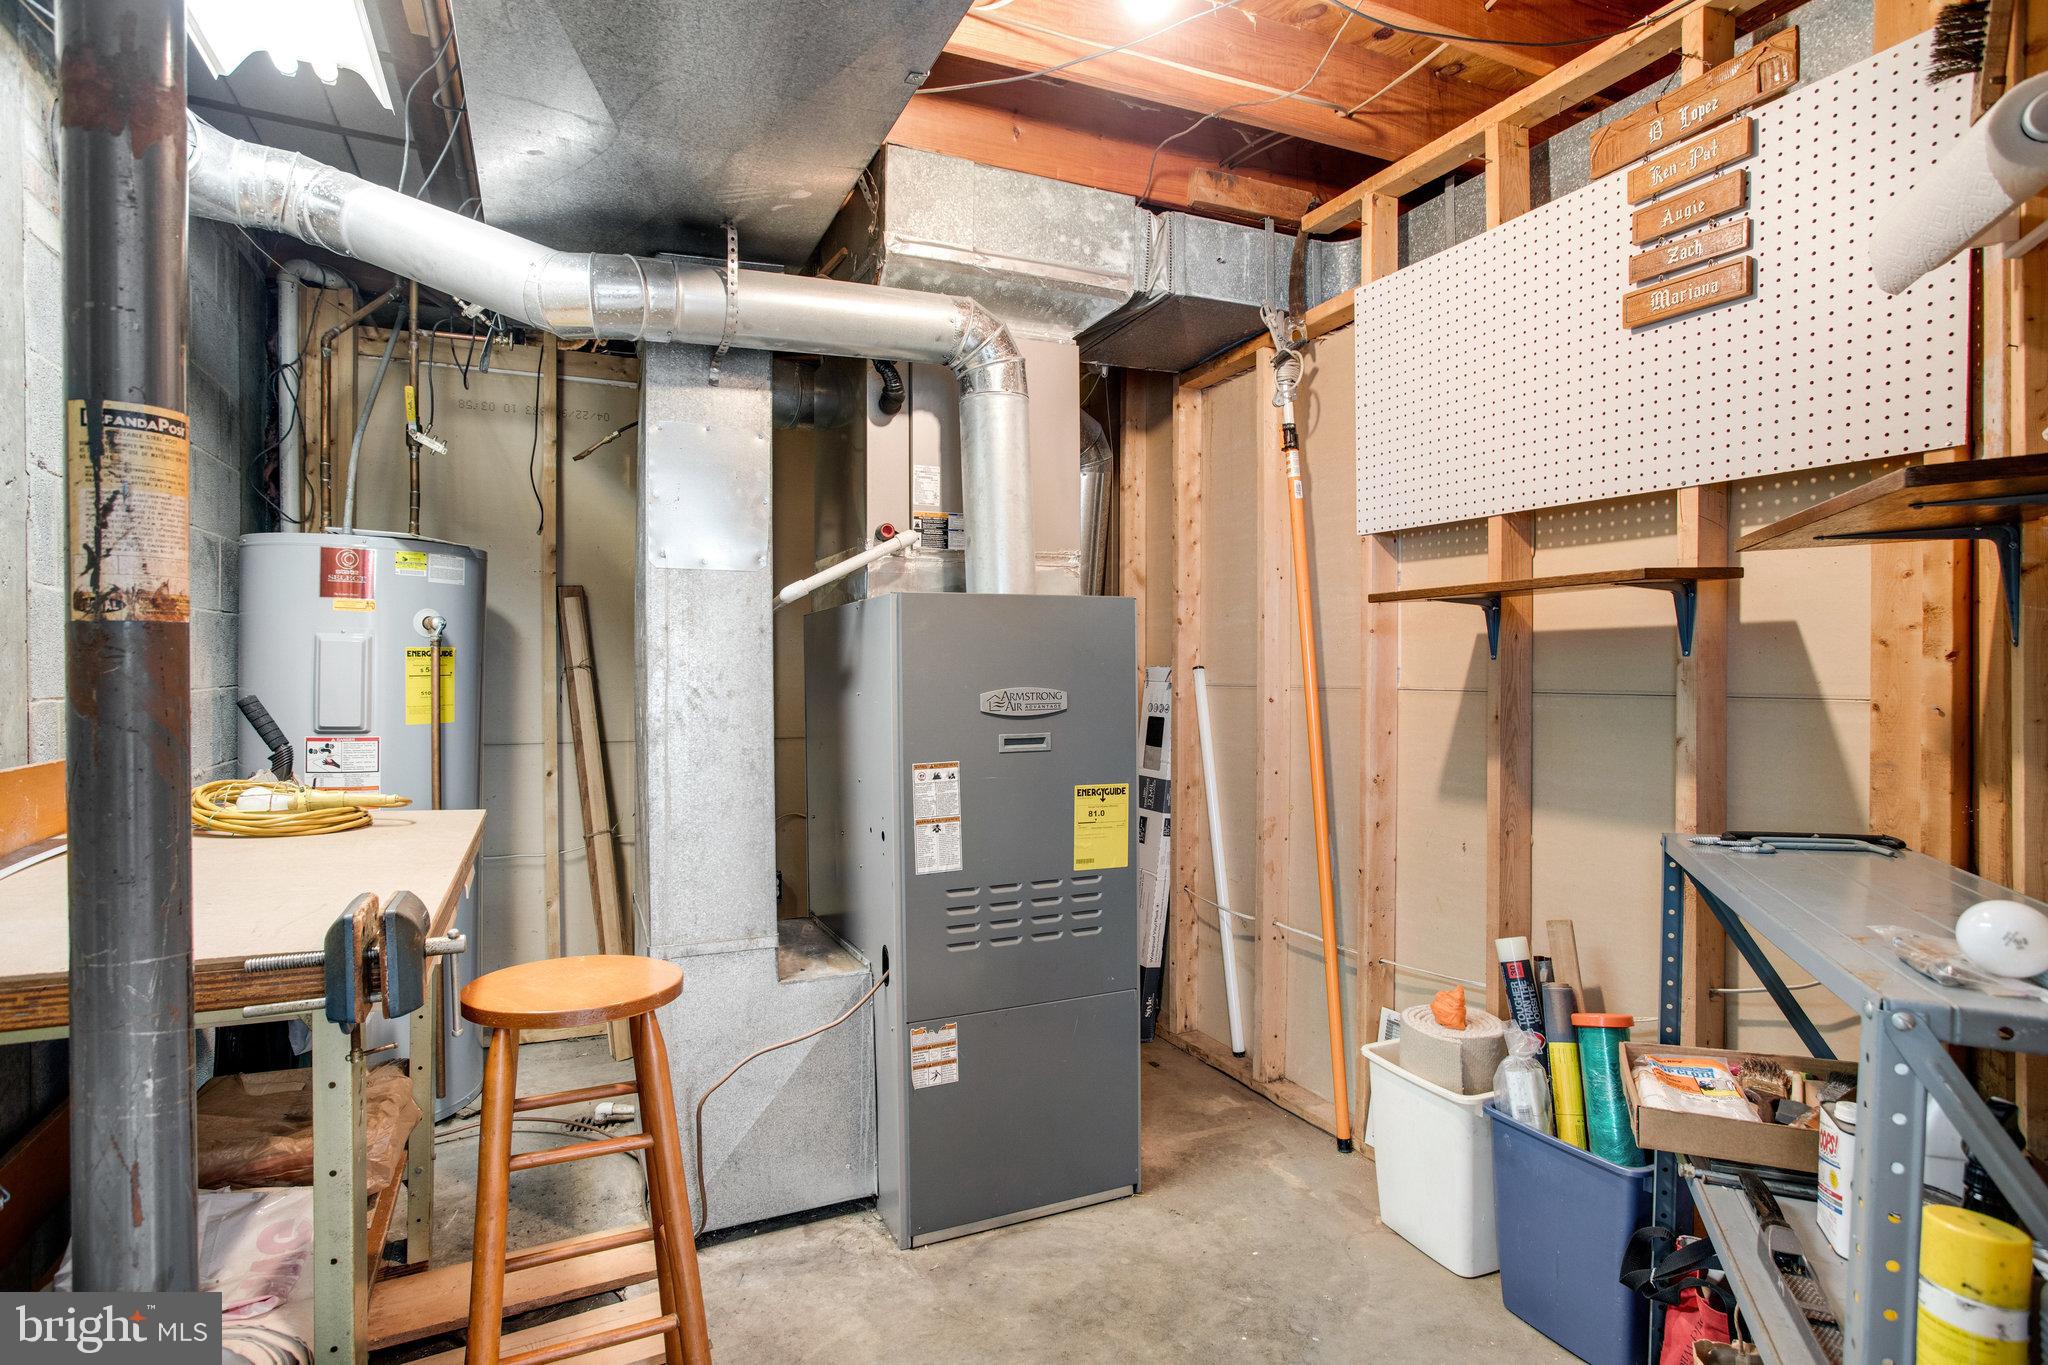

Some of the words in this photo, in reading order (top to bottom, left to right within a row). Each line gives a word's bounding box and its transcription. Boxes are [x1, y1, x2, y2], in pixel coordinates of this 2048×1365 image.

[1679, 98, 1719, 131] Lopez
[1660, 200, 1706, 228] Augie
[1667, 239, 1704, 265] Zach
[1650, 281, 1719, 312] Mariana
[1001, 691, 1063, 701] ARMSTRONG
[1005, 701, 1023, 711] AIR
[1077, 787, 1126, 798] ENERGYGUIDE
[1520, 980, 1529, 1001] THE
[1510, 981, 1528, 1026] TOUGHER
[1522, 1001, 1536, 1025] THAN
